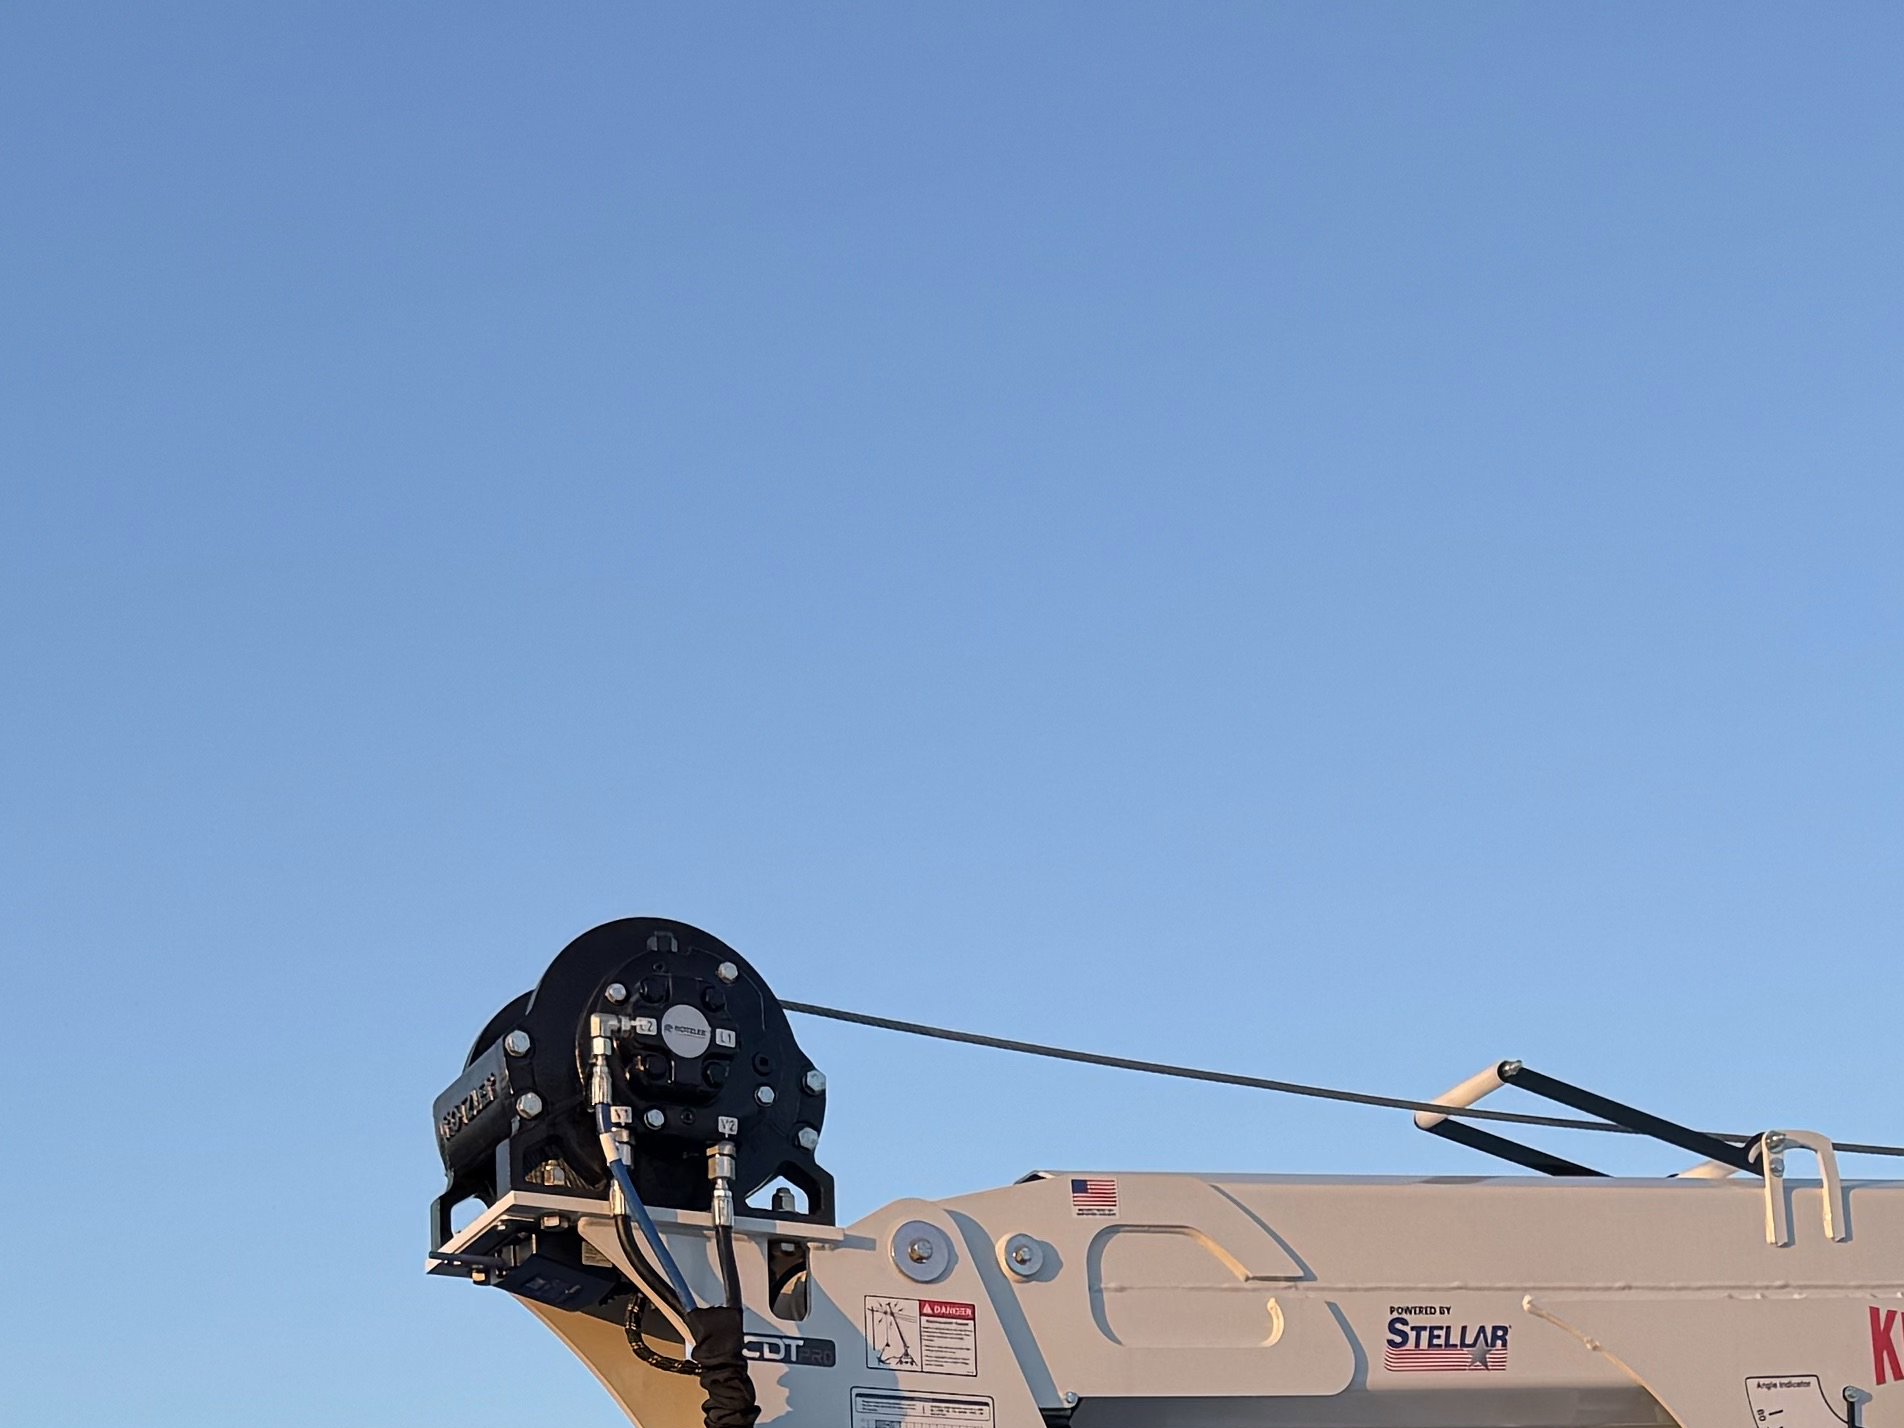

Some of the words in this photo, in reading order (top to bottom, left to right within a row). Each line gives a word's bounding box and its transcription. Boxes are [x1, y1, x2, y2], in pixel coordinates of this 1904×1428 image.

[1389, 1305, 1437, 1315] POWERED
[1439, 1305, 1452, 1315] BY
[1386, 1316, 1509, 1349] STELLAR
